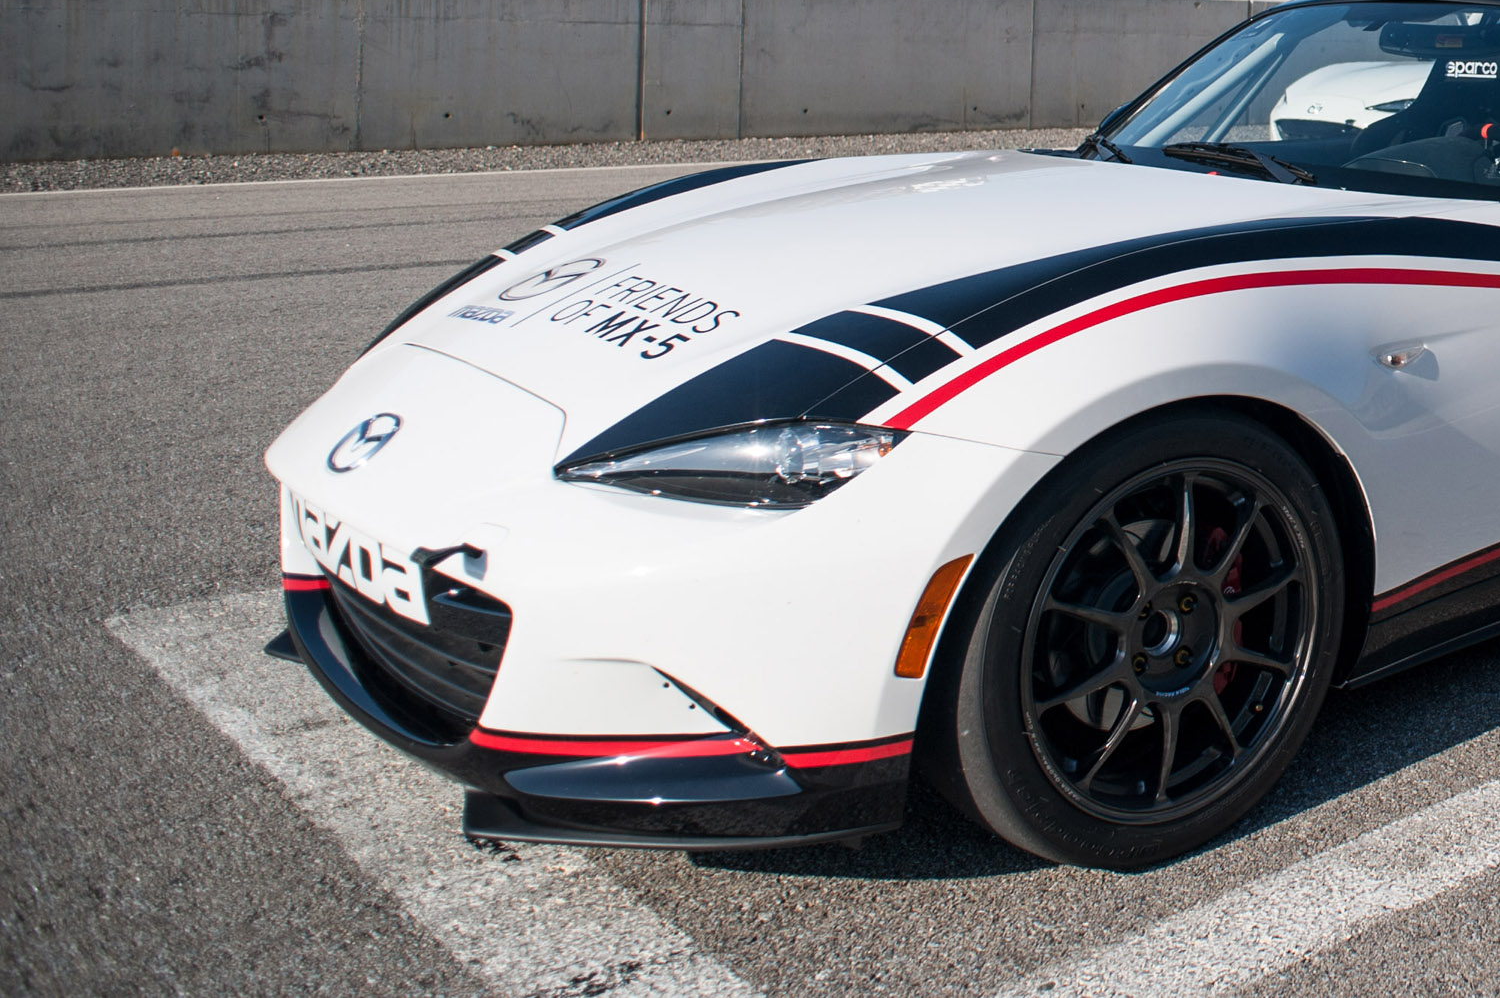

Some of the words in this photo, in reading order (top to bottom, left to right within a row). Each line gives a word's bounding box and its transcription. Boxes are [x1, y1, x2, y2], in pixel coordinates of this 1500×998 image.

[1447, 61, 1498, 78] sparco
[448, 304, 515, 325] mazda
[594, 276, 741, 334] FRIENDS
[550, 299, 613, 325] OF
[584, 310, 691, 360] MX-5
